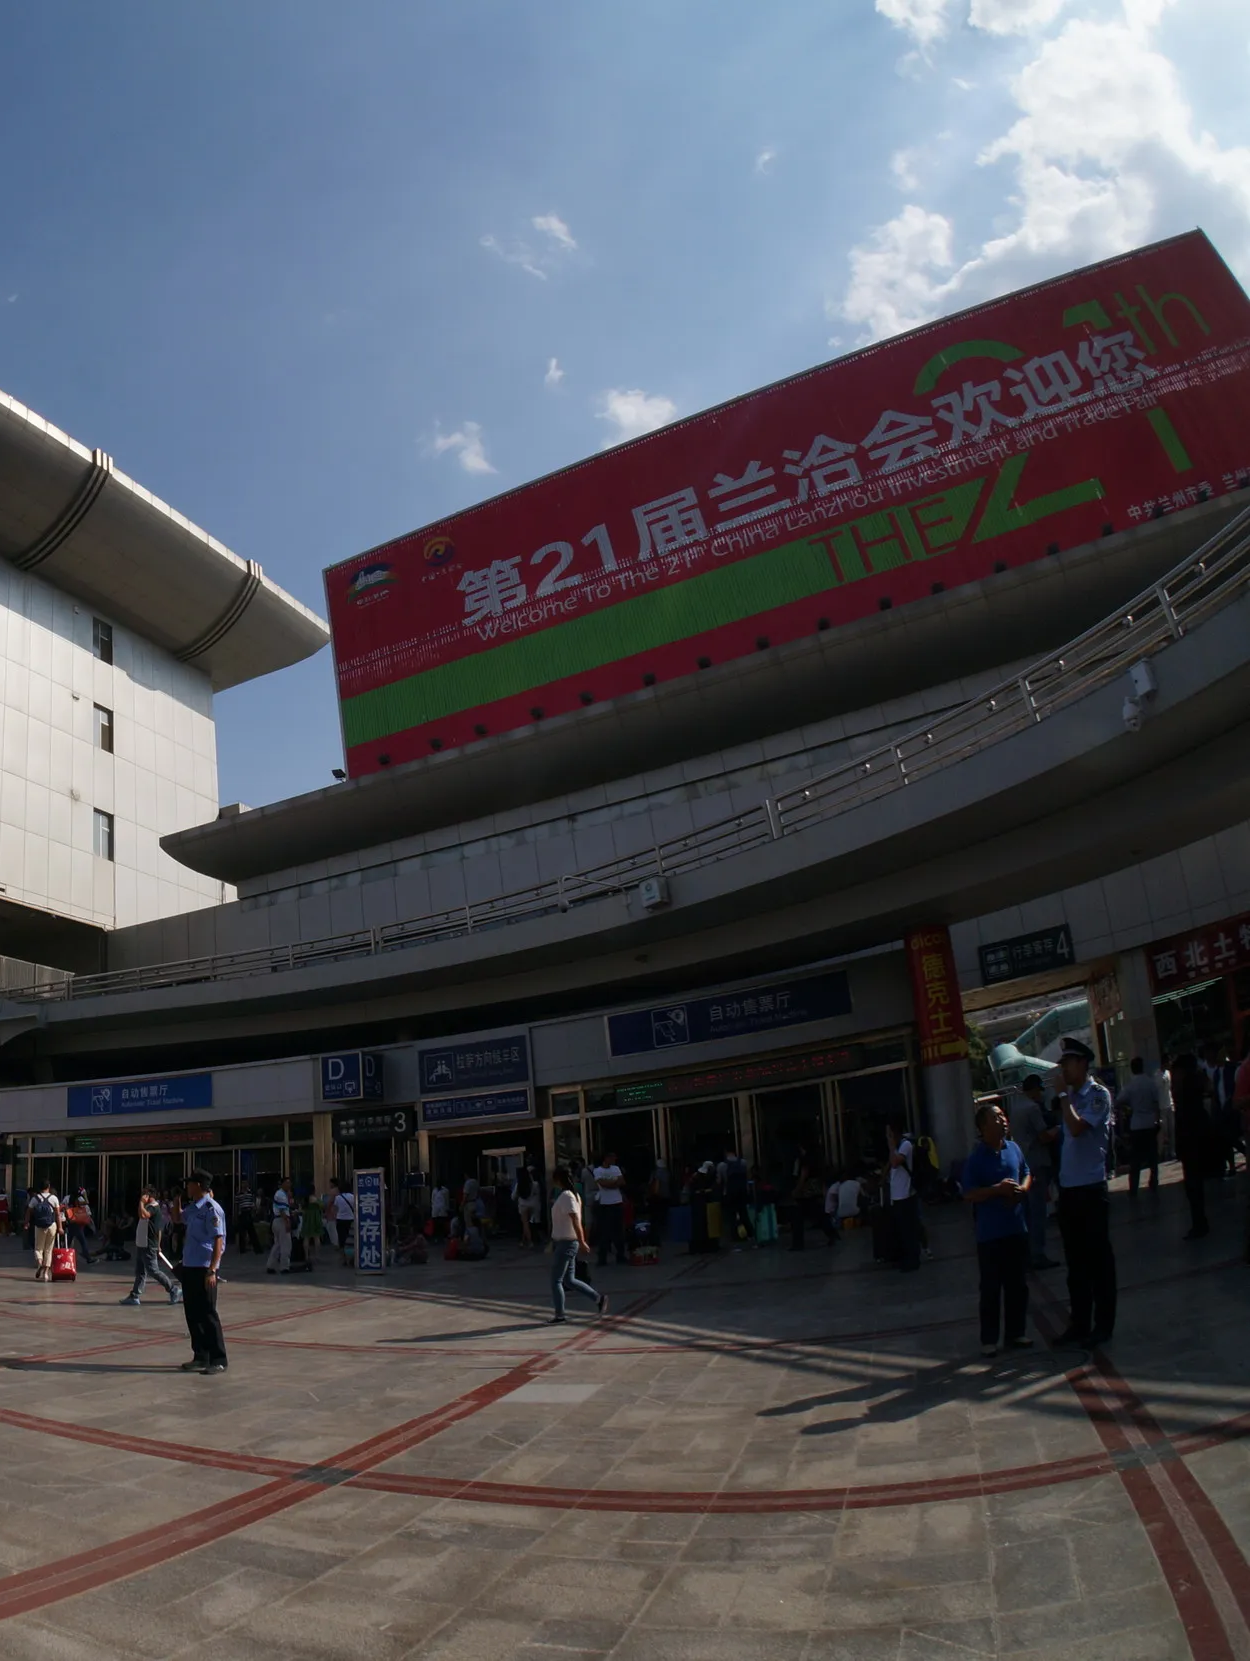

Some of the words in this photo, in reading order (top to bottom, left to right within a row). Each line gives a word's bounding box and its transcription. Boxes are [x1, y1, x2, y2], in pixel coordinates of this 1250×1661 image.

[456, 329, 1156, 627] 第21届兰洽会欢迎您
[1221, 467, 1250, 490] 兰州
[476, 593, 578, 641] Welcome
[582, 582, 611, 603] To
[615, 561, 659, 591] The
[711, 520, 781, 557] China
[785, 486, 884, 531] Lanzhou
[887, 440, 1012, 497] Investment
[1016, 420, 1058, 451] and
[1061, 401, 1121, 433] Trade
[807, 496, 958, 582] THE
[1056, 930, 1070, 960] 4
[710, 991, 791, 1022] 自动售票厅
[921, 953, 954, 1036] 德克士
[328, 1058, 345, 1081] D
[364, 1055, 376, 1077] D
[121, 1084, 168, 1099] 自动售票厅
[393, 1111, 407, 1133] 3
[358, 1191, 382, 1269] 寄存处
